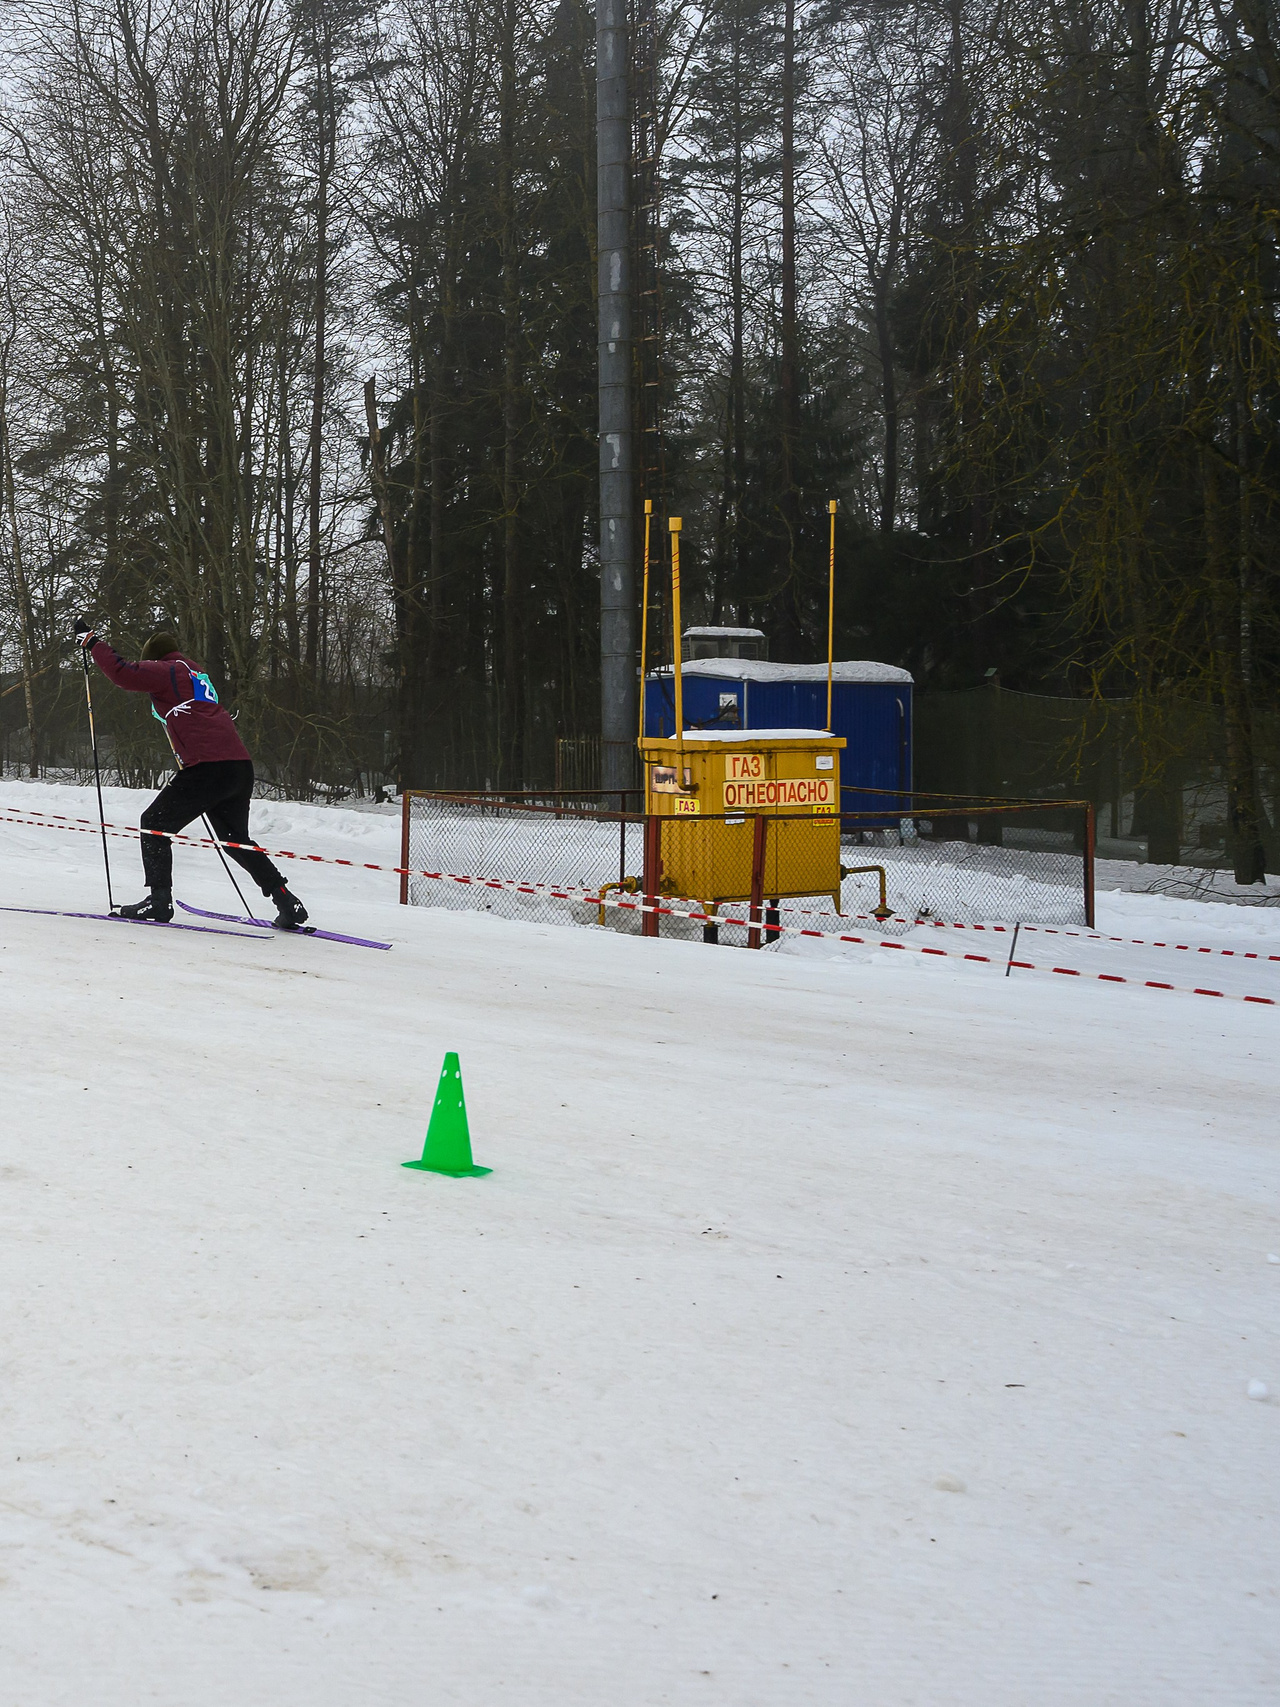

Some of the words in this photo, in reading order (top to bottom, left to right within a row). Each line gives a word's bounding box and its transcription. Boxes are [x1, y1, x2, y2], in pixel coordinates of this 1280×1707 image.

[732, 756, 761, 777] ГАЗ
[725, 780, 828, 805] ОГНЕОПАСНО
[678, 800, 696, 812] ГАЗ
